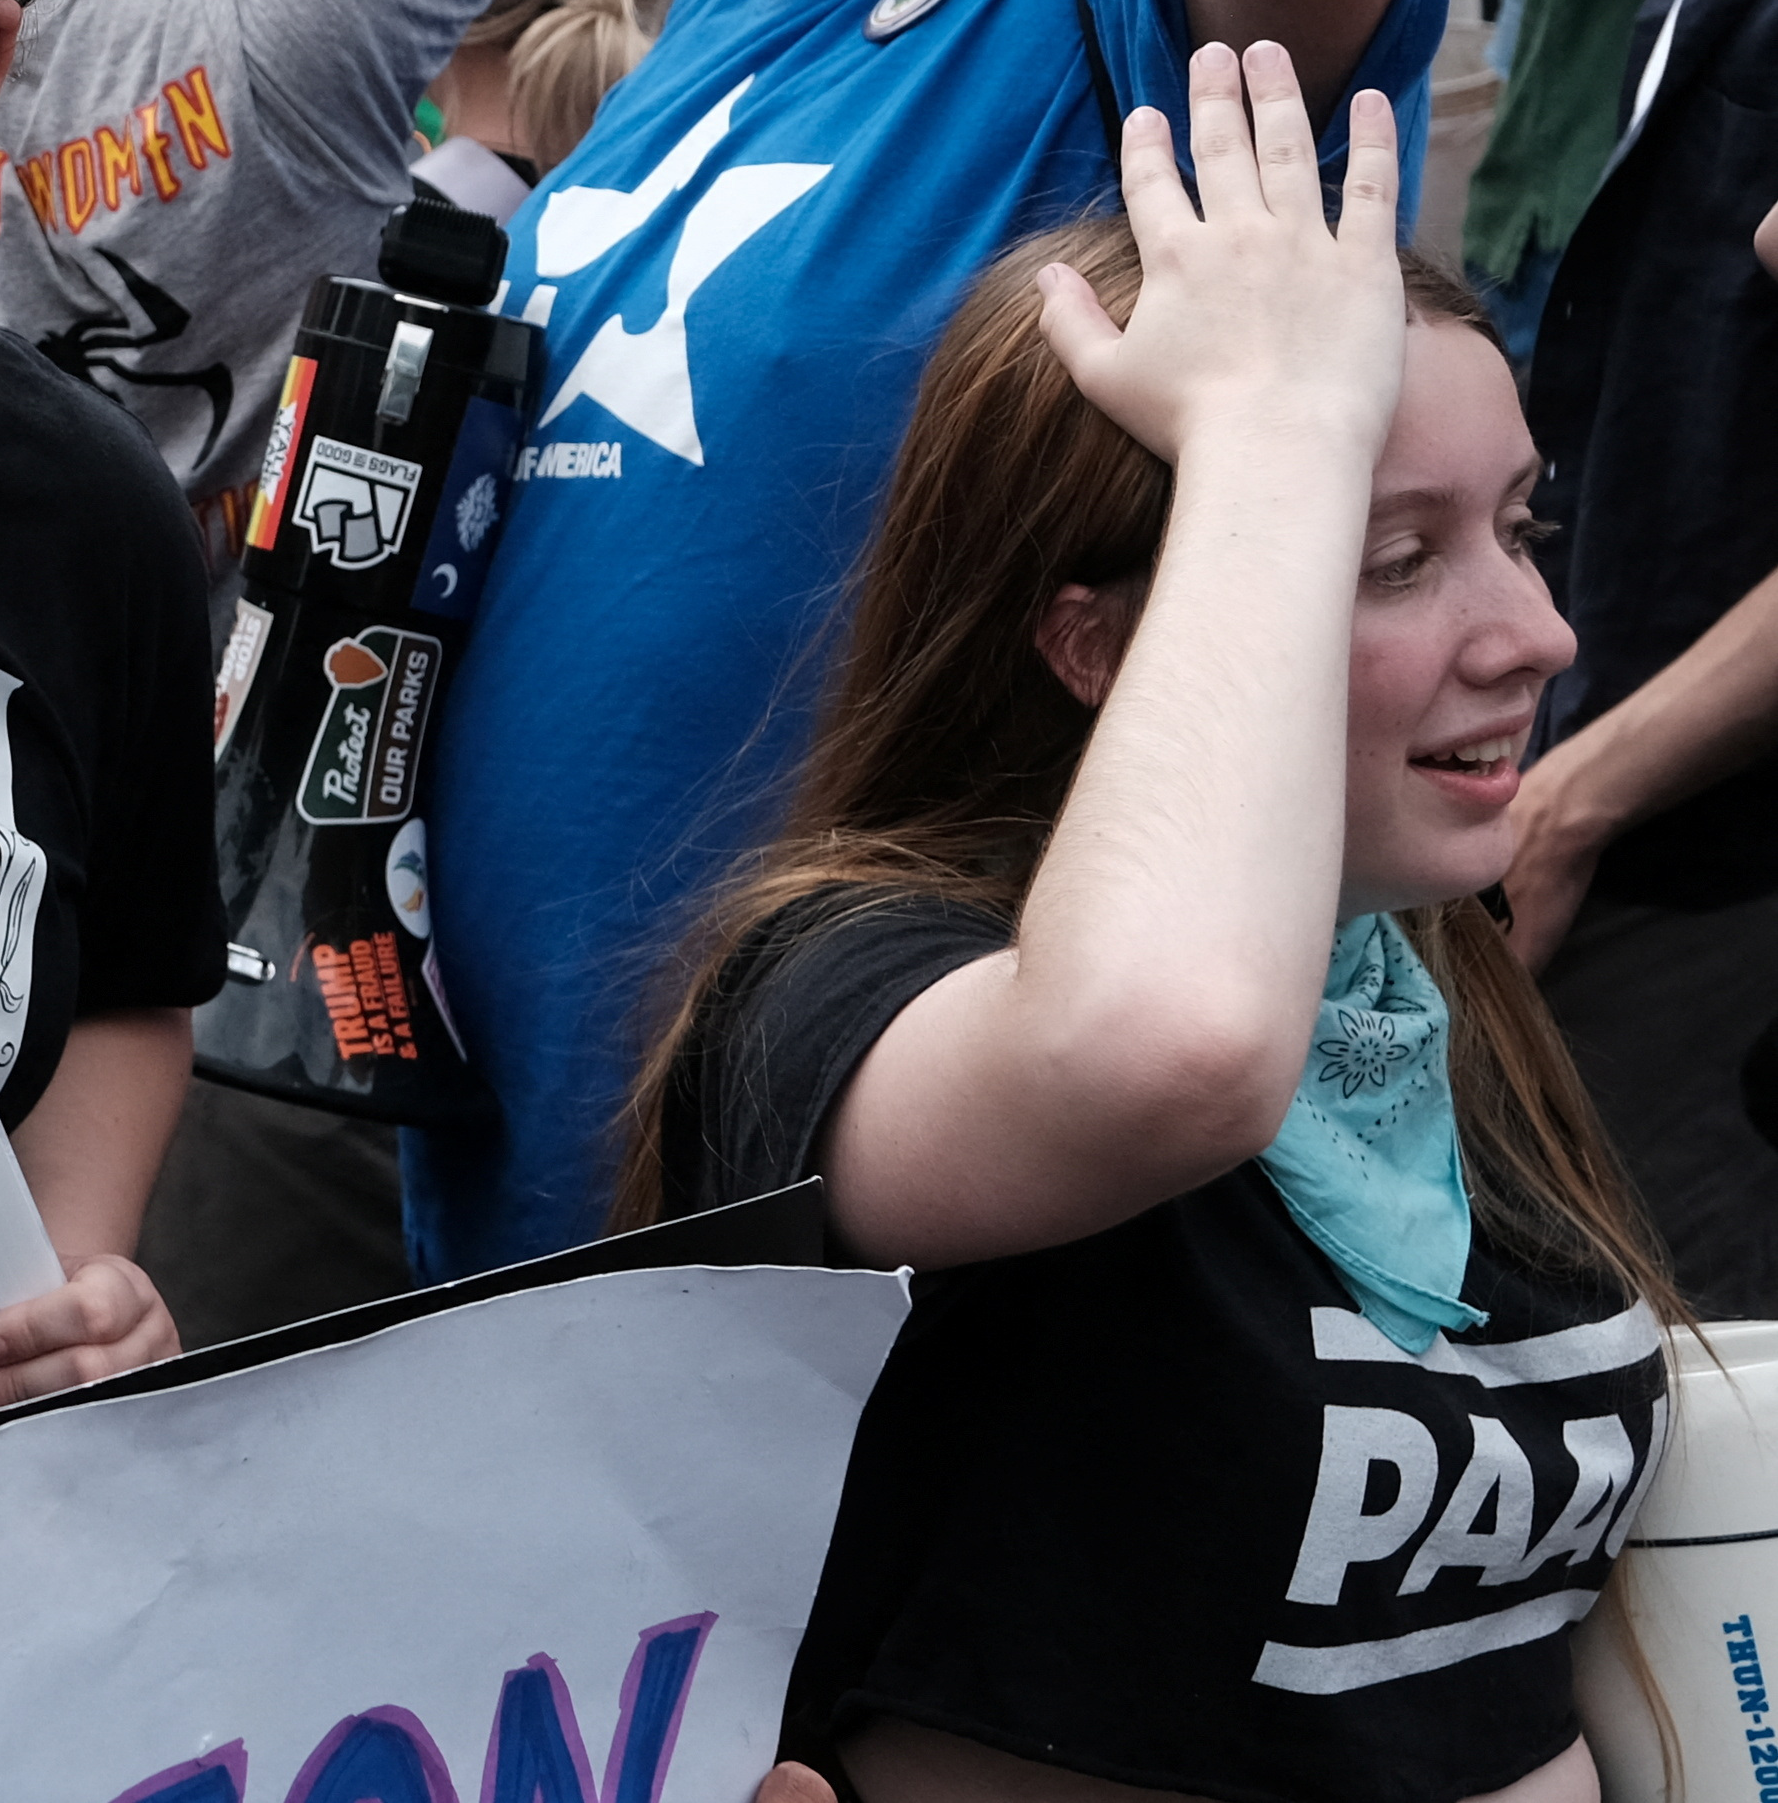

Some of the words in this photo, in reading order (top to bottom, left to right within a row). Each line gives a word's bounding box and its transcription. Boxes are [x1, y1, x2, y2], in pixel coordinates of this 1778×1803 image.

[316, 441, 352, 464] GOOD
[368, 457, 419, 483] FLAGS
[390, 650, 430, 744] PARKS
[322, 702, 372, 806] Protect
[379, 748, 408, 806] OUR
[349, 939, 386, 1011] FRAUD
[373, 931, 411, 1019] FAILURE
[312, 944, 374, 1061] TRUMP
[368, 1014, 390, 1031] A
[373, 1033, 395, 1055] IS
[394, 1023, 413, 1038] A
[399, 1042, 418, 1059] &
